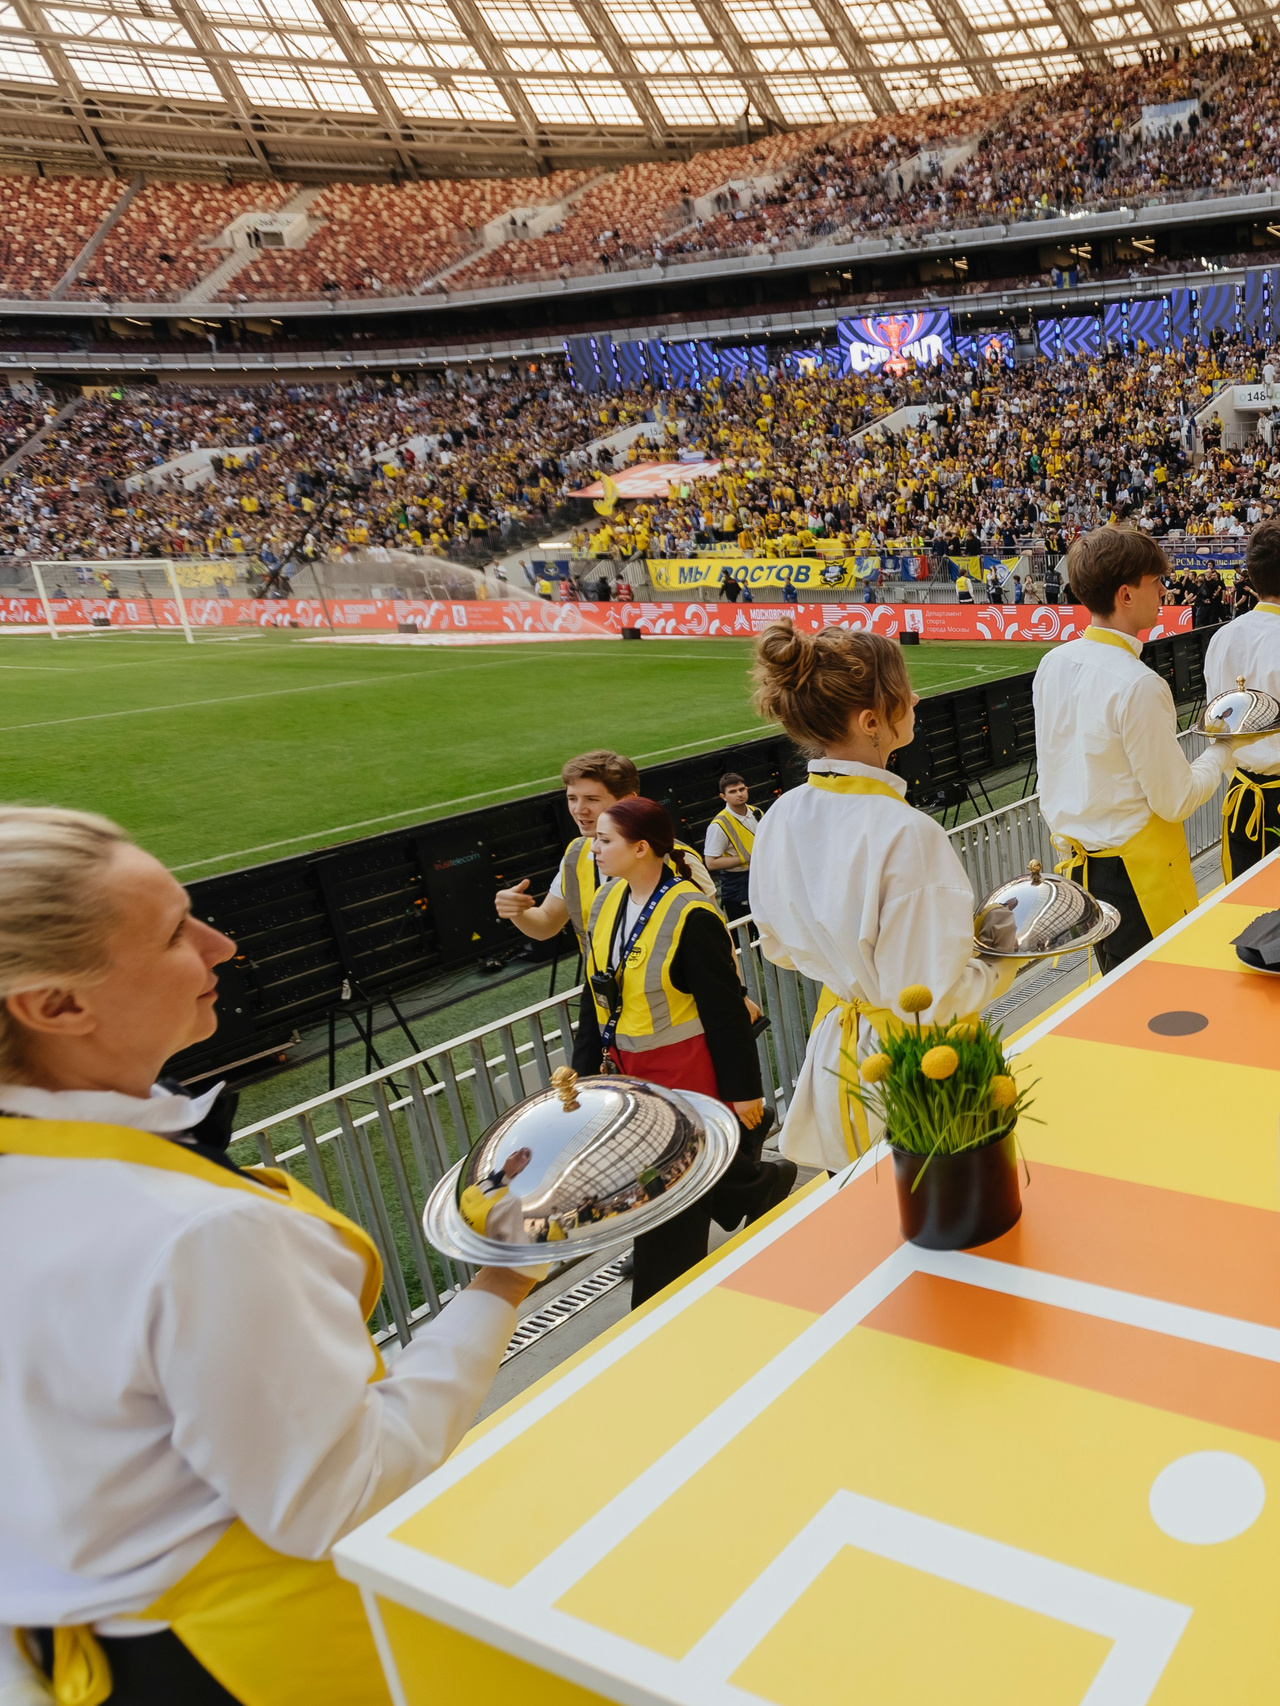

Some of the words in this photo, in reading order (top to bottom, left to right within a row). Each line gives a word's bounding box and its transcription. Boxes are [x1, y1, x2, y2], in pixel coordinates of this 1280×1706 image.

[1247, 390, 1267, 402] 148
[678, 564, 712, 585] МЫ
[925, 610, 962, 618] Департамент
